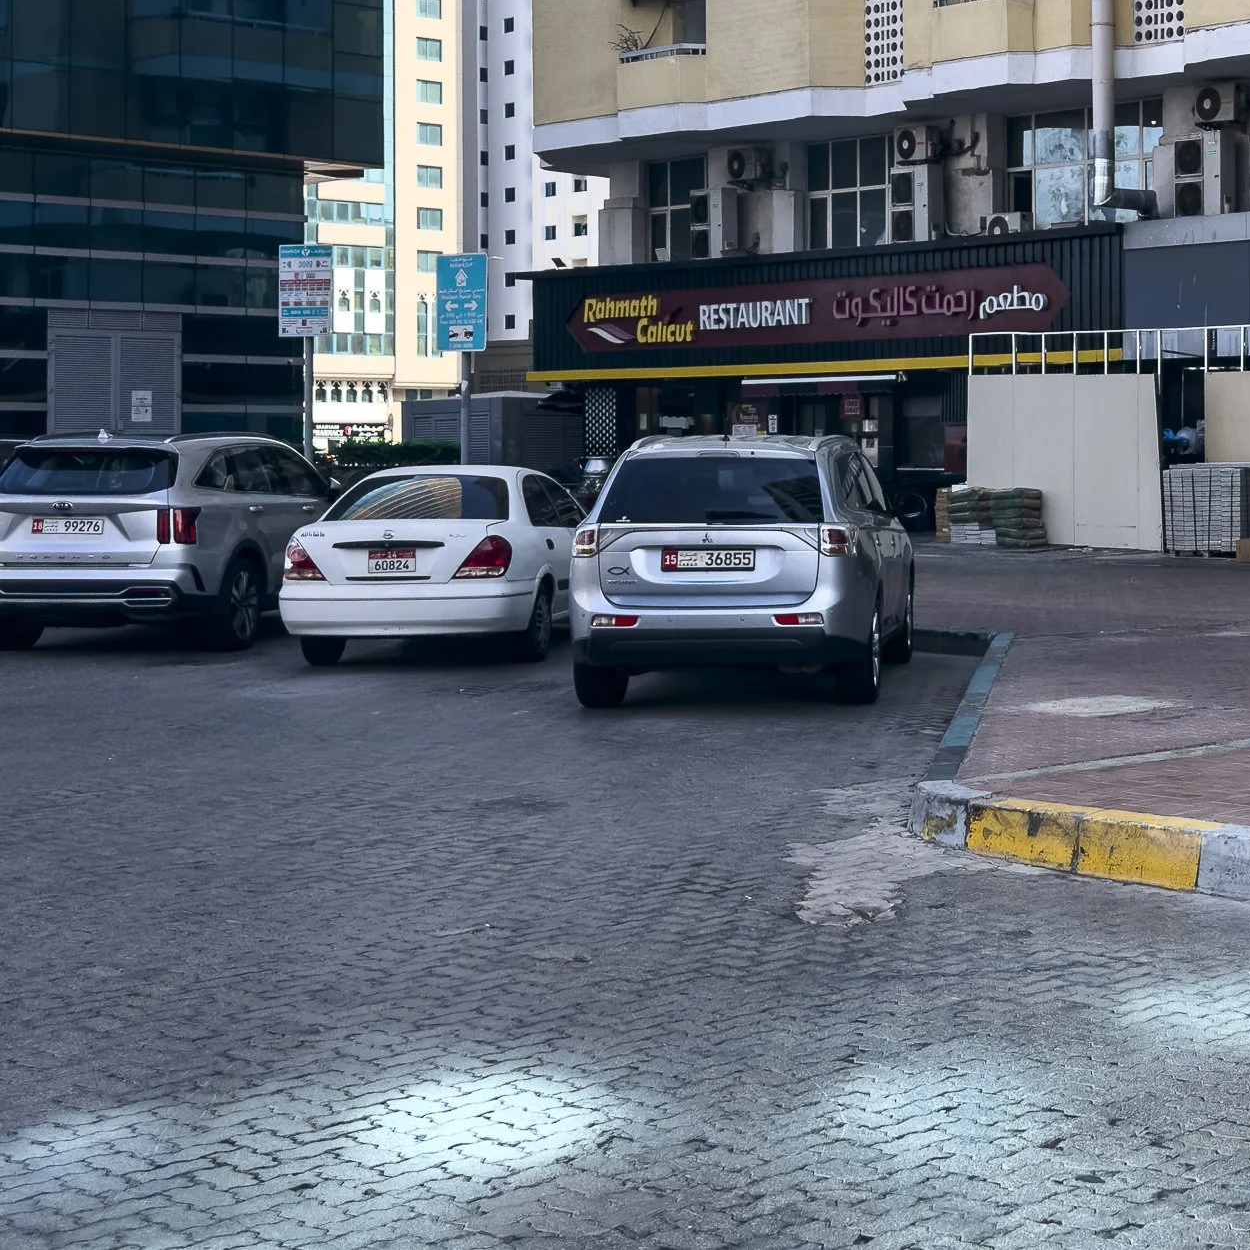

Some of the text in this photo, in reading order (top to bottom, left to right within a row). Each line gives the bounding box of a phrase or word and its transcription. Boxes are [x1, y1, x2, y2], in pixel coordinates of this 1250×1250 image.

[583, 295, 658, 323] Rahmath
[699, 298, 812, 330] RESTAURANT
[832, 284, 1045, 327] مطعم رحمت كاليكوت
[636, 317, 694, 343] Calicut
[33, 521, 43, 531] 18
[64, 520, 100, 532] 99276
[374, 559, 410, 571] 60824
[388, 551, 397, 559] 14
[664, 554, 677, 565] 15
[705, 551, 752, 566] 36855
